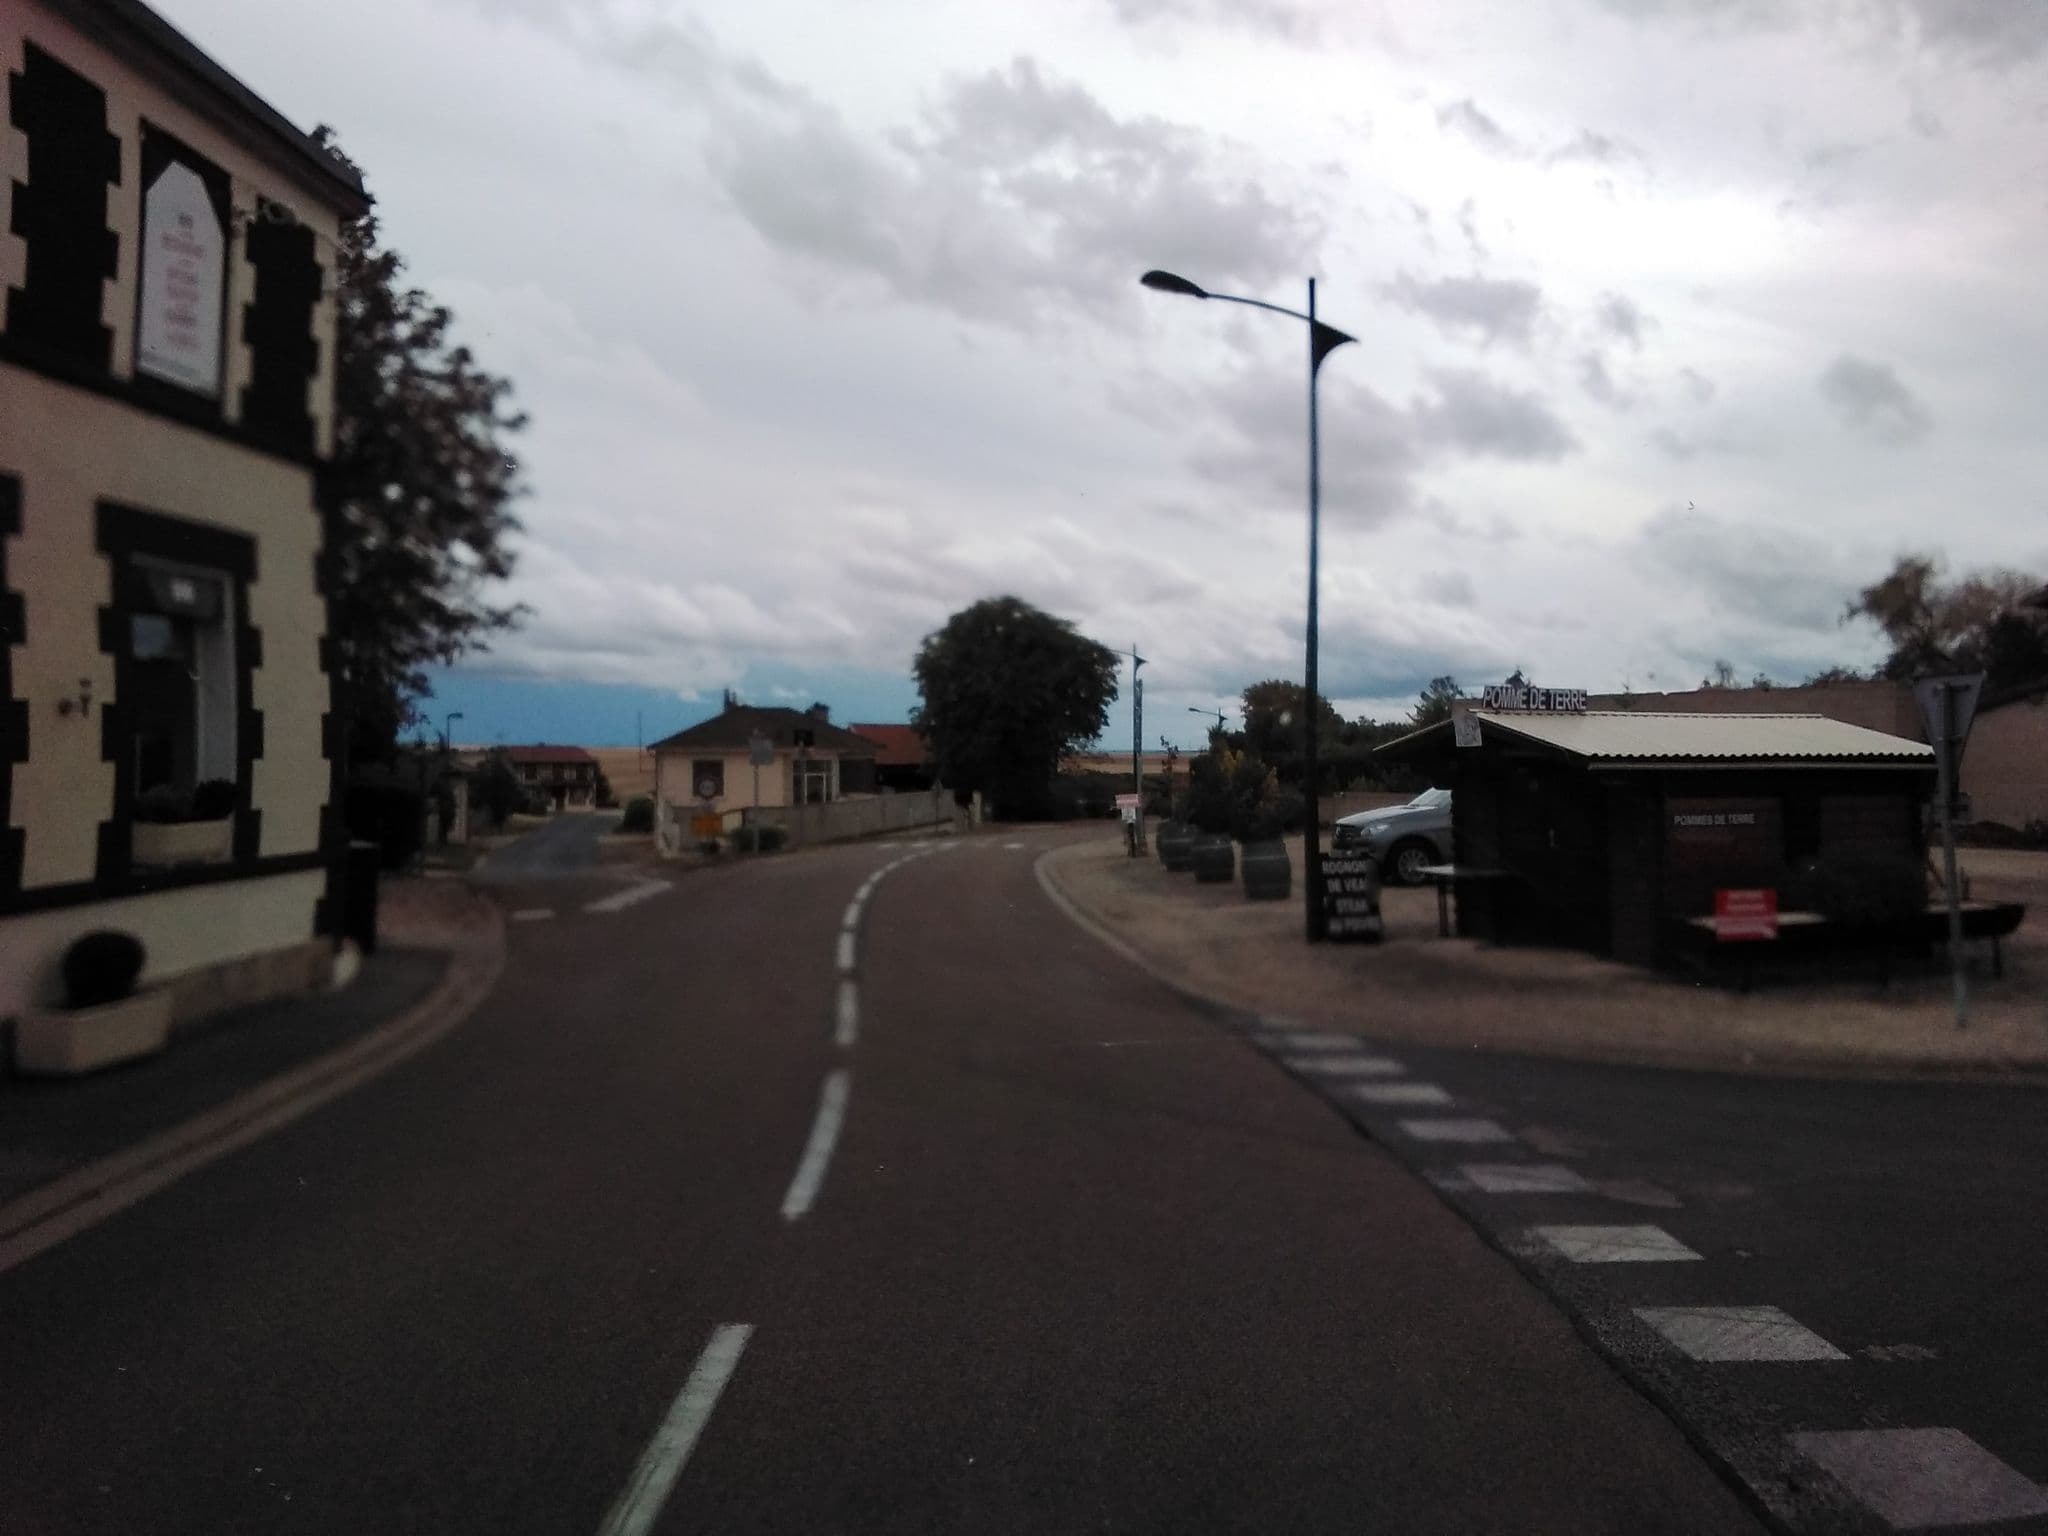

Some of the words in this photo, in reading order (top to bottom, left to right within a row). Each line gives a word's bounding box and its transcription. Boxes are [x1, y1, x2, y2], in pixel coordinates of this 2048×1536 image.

[1482, 686, 1527, 709] POMME
[1530, 688, 1546, 710] DE
[1550, 690, 1587, 710] TERRE
[1673, 815, 1713, 825] POMMES
[1714, 814, 1726, 825] DE
[1728, 813, 1755, 825] TERRE
[1327, 878, 1342, 893] DE
